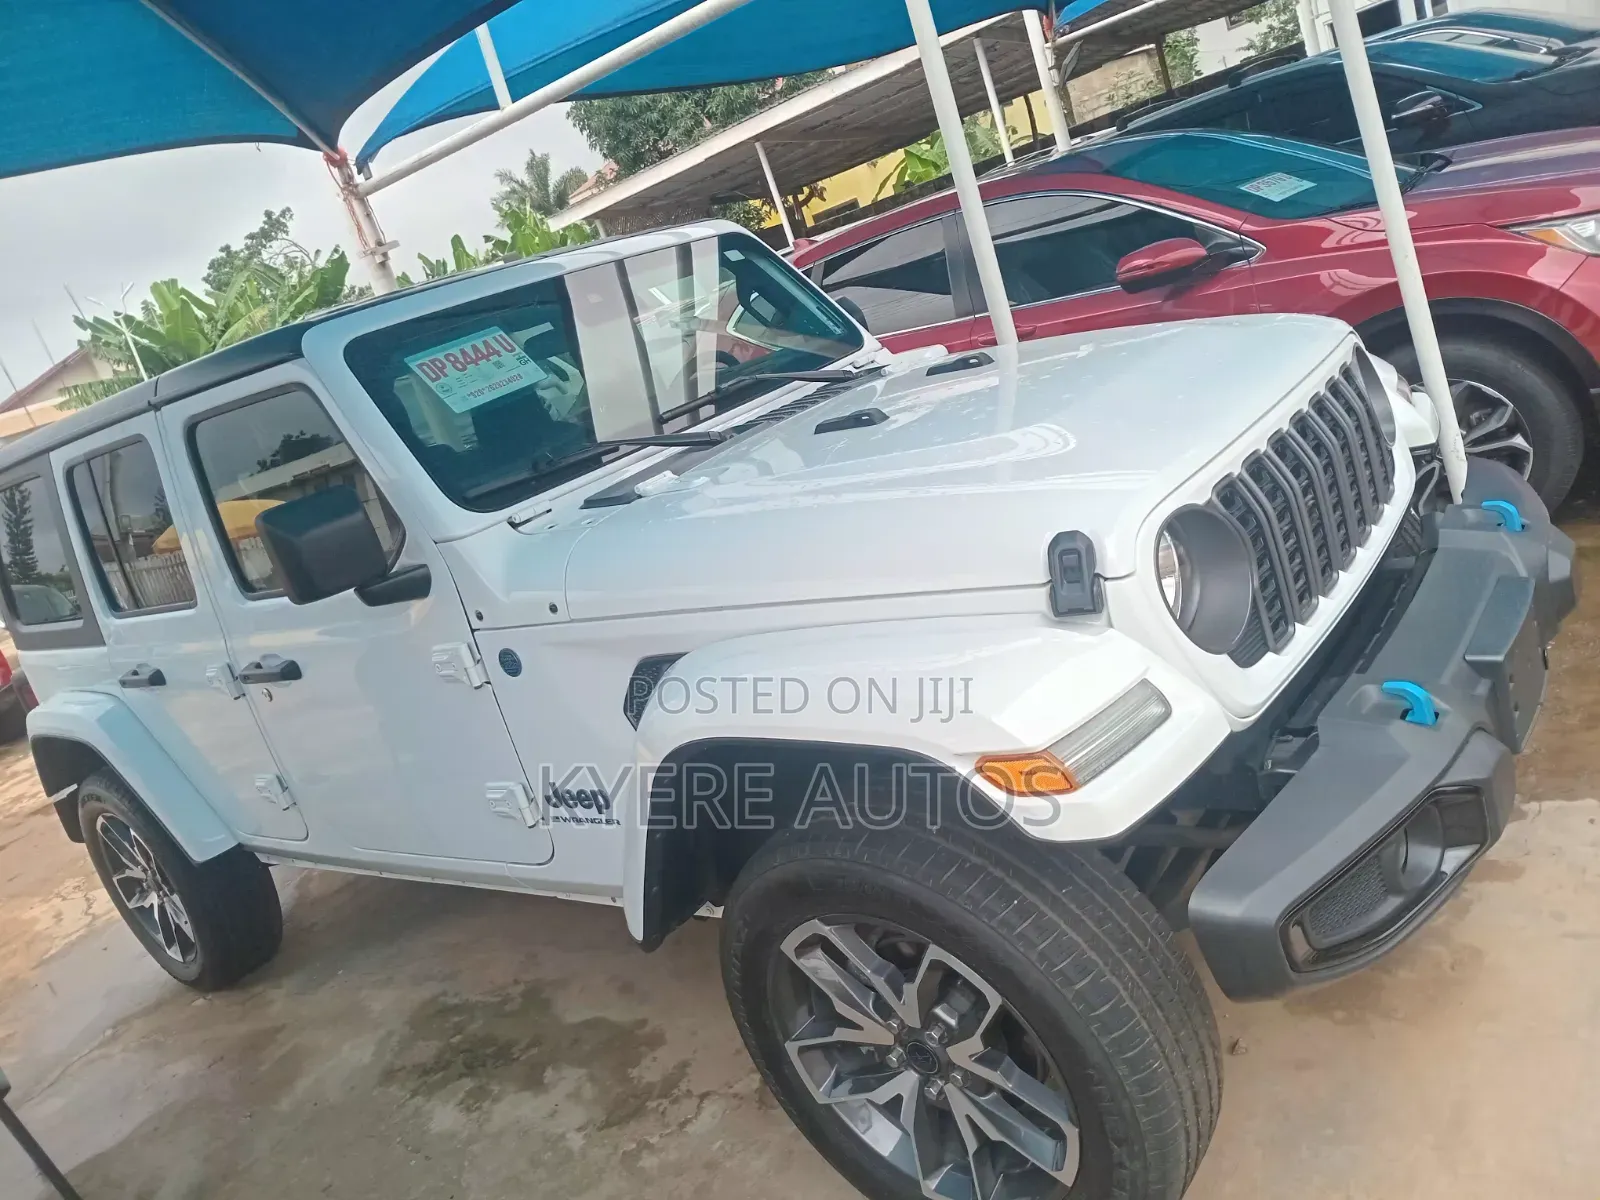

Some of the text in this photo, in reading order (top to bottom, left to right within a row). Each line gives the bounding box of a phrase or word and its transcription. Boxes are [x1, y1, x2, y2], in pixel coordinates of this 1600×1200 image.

[415, 357, 449, 383] DP
[443, 339, 503, 372] 8444
[492, 333, 516, 353] U
[519, 357, 531, 366] GH
[544, 781, 611, 814] Jeep
[559, 816, 621, 826] WRANGLER
